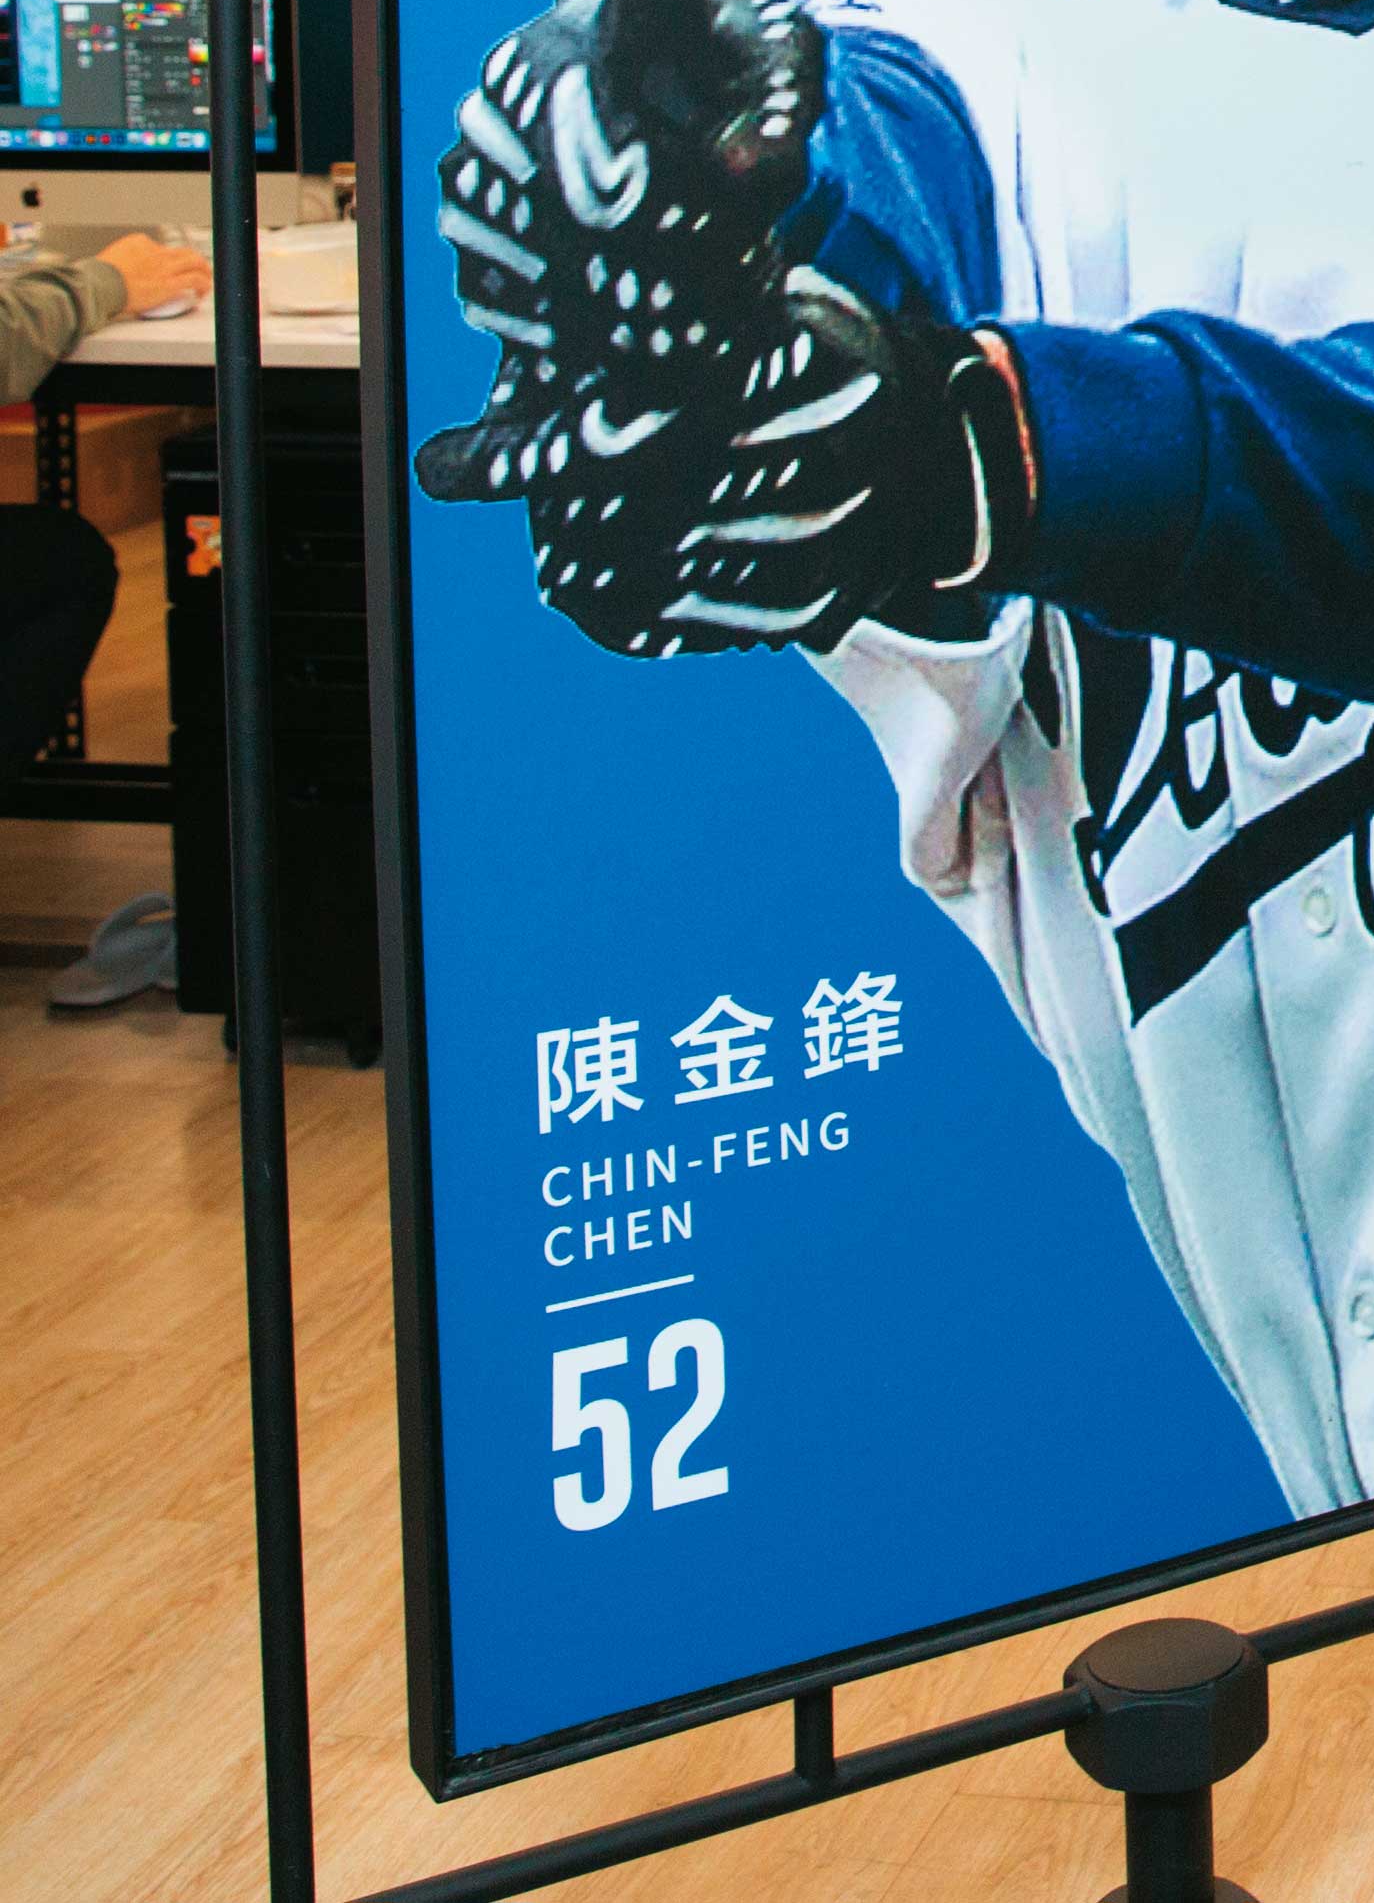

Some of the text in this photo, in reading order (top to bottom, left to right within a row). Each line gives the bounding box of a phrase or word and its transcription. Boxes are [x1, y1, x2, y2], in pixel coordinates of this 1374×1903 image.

[536, 971, 904, 1135] 陳金鋒
[541, 1111, 851, 1208] CHIN-FENG
[543, 1200, 693, 1268] CHEN
[551, 1317, 730, 1532] 52
